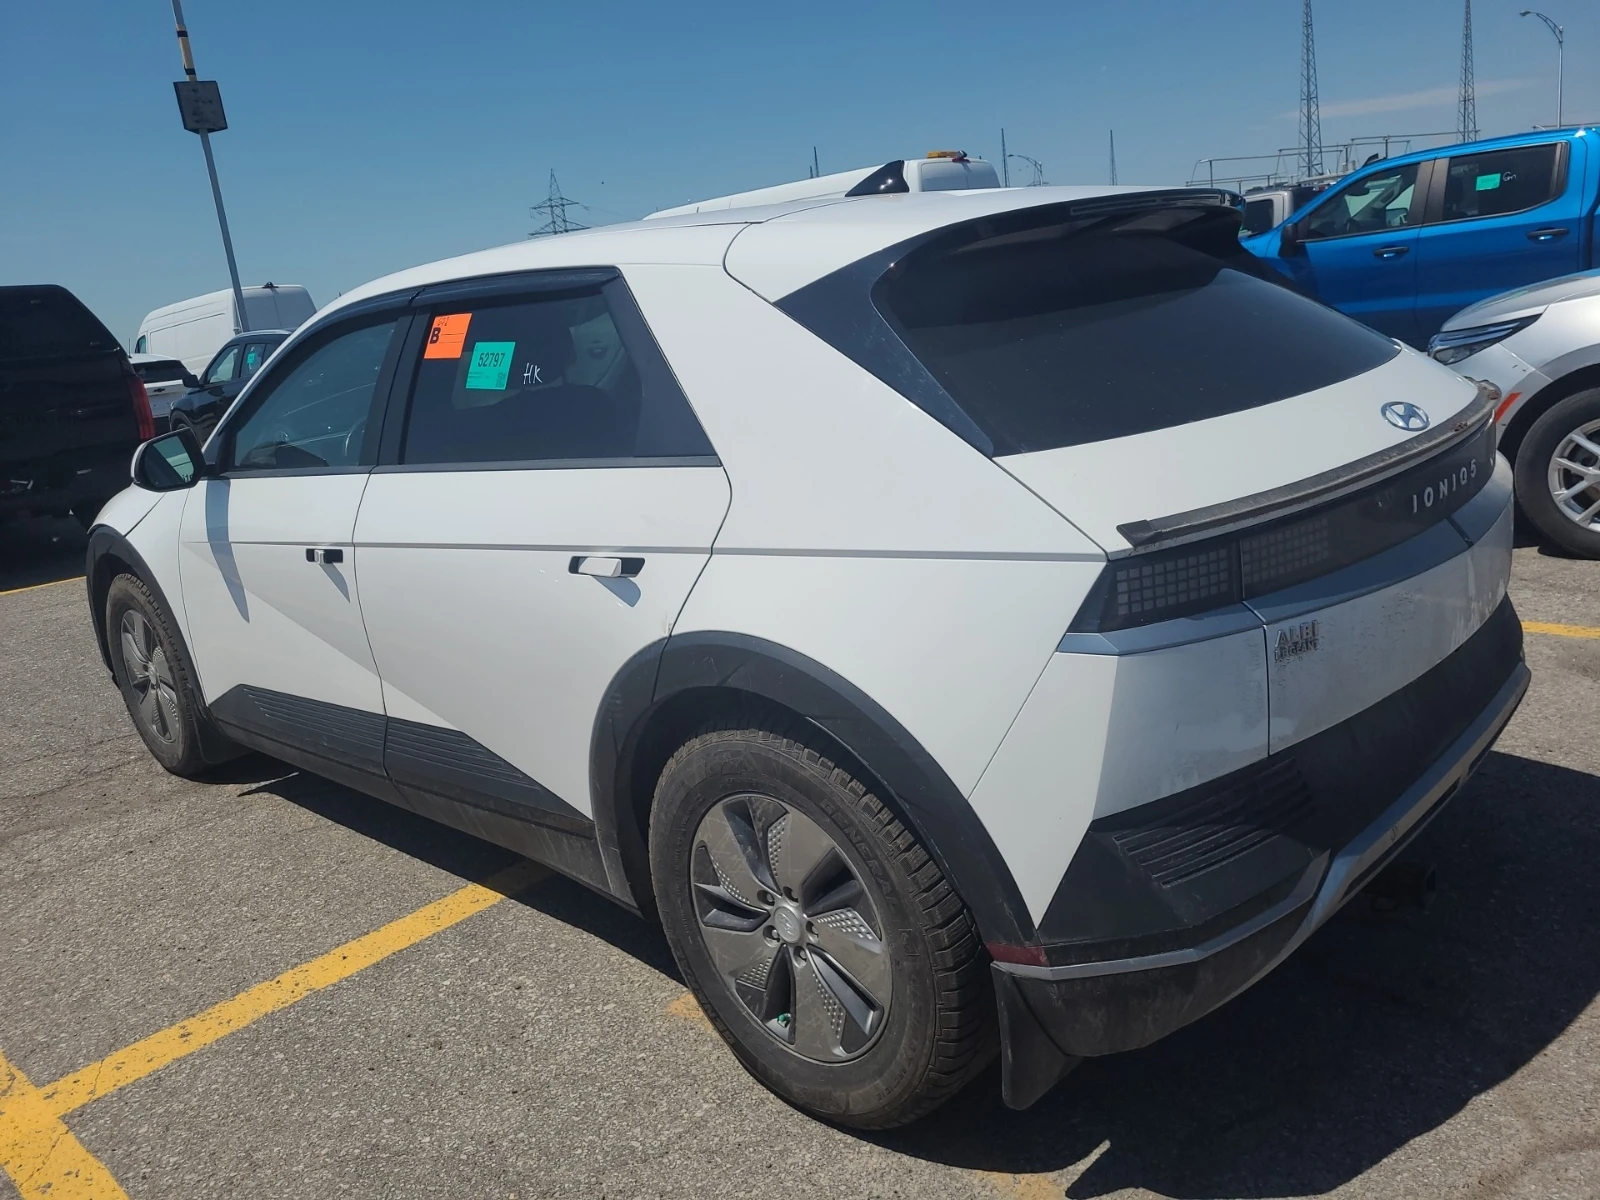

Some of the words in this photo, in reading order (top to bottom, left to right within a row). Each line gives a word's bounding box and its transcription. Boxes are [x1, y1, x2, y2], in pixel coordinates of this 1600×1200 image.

[430, 327, 441, 344] B
[478, 352, 505, 367] 52797
[523, 362, 543, 384] HK
